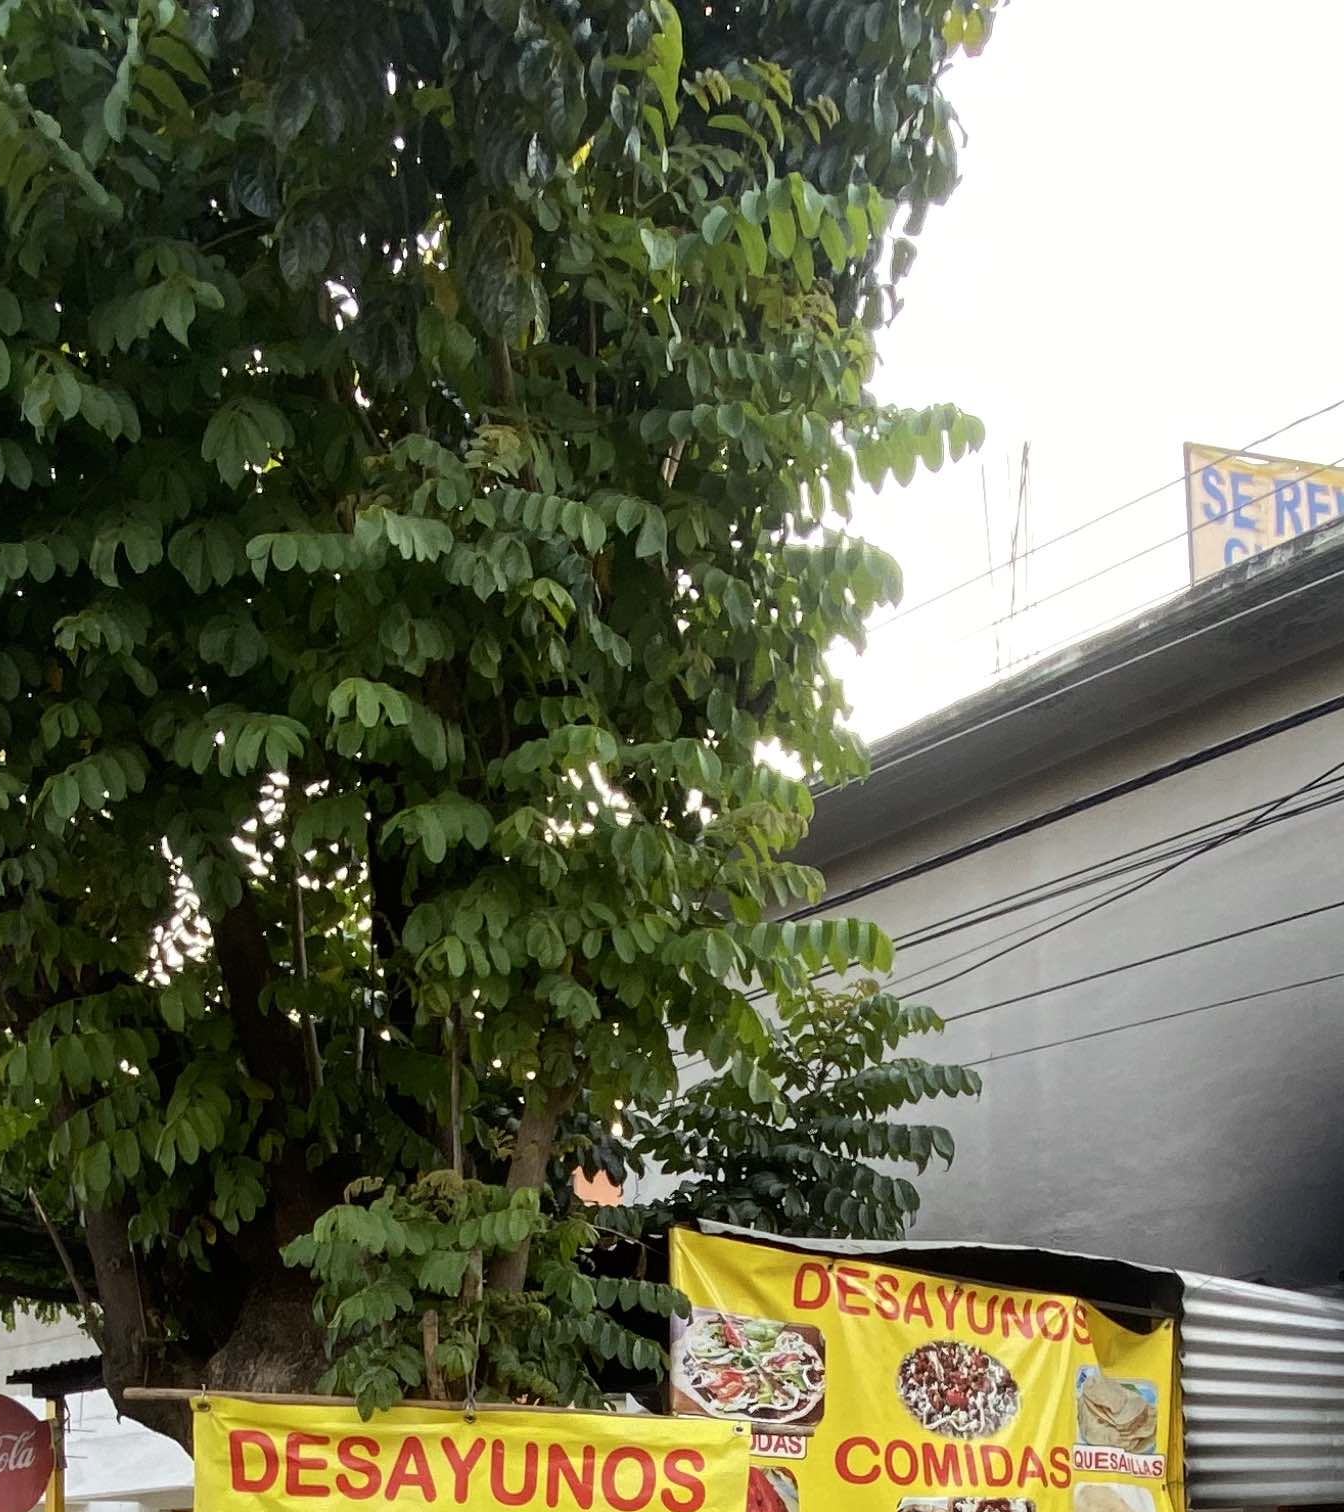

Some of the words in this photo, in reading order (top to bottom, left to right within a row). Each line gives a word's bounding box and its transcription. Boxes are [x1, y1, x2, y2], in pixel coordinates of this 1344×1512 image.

[1202, 466, 1256, 529] SE
[793, 1262, 1093, 1345] DESAYUNOS
[834, 1437, 1073, 1488] COMIDAS
